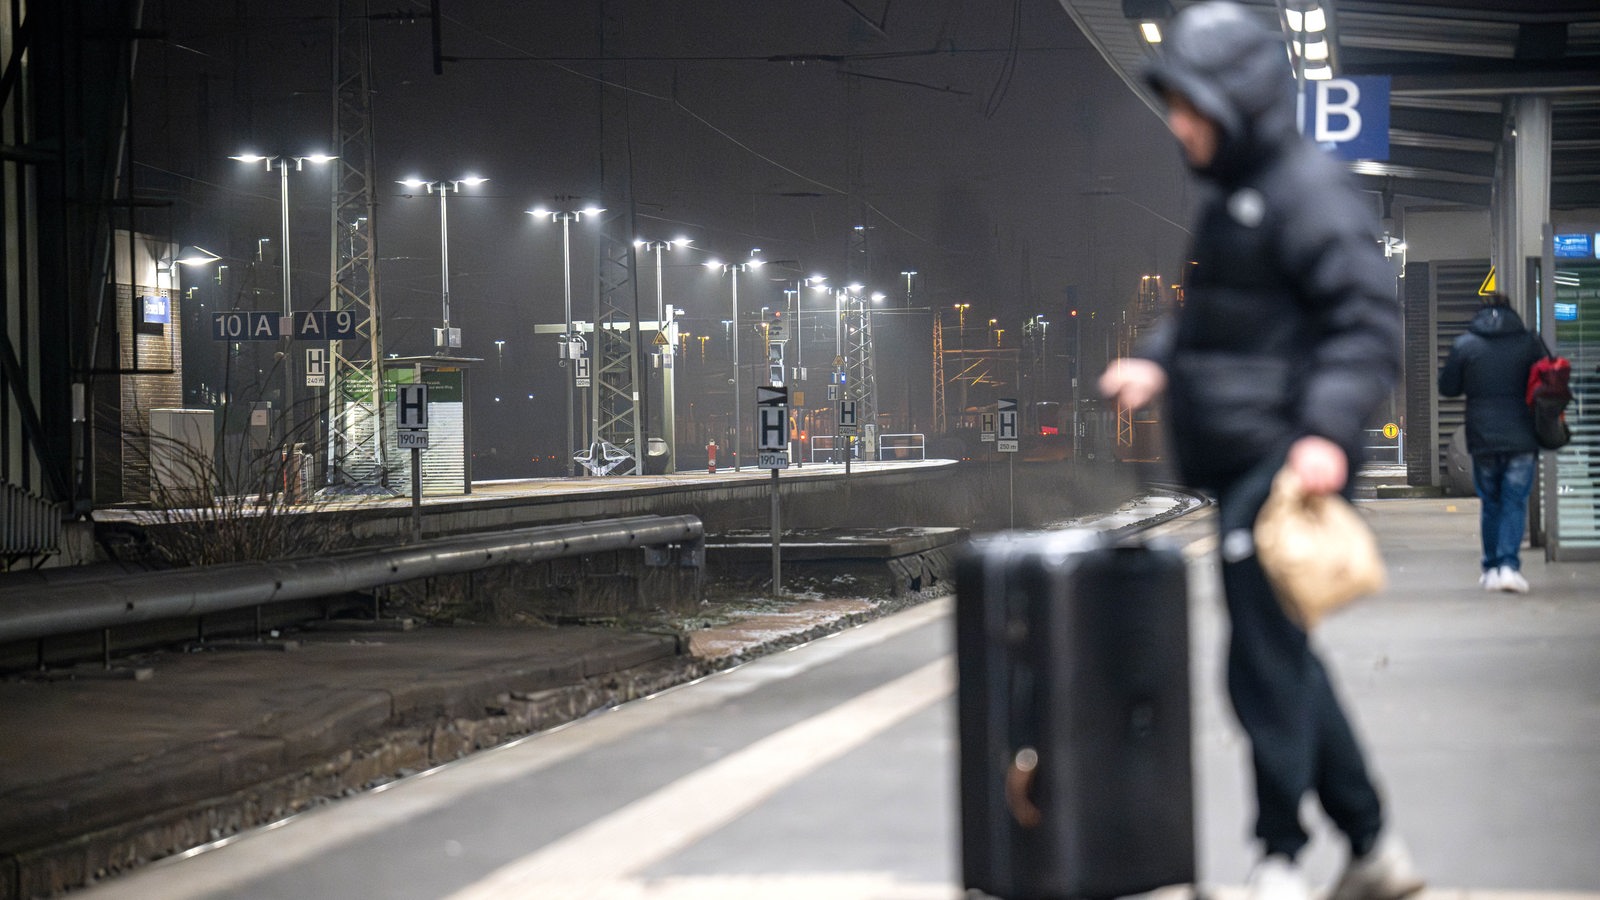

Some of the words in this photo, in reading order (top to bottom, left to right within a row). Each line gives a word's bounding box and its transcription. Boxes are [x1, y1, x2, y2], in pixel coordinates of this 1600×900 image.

[1315, 79, 1362, 142] B
[215, 315, 242, 337] 10
[255, 315, 273, 337] A
[301, 312, 320, 334] A
[336, 311, 351, 334] 9
[308, 351, 323, 373] H
[577, 359, 588, 376] H
[829, 386, 837, 399] H
[400, 387, 424, 425] H
[841, 401, 855, 423] H
[761, 409, 784, 446] H
[982, 414, 993, 431] H
[1000, 413, 1015, 437] H
[400, 434, 415, 445] 190
[416, 436, 427, 444] m
[760, 455, 776, 465] 190
[776, 457, 787, 465] m
